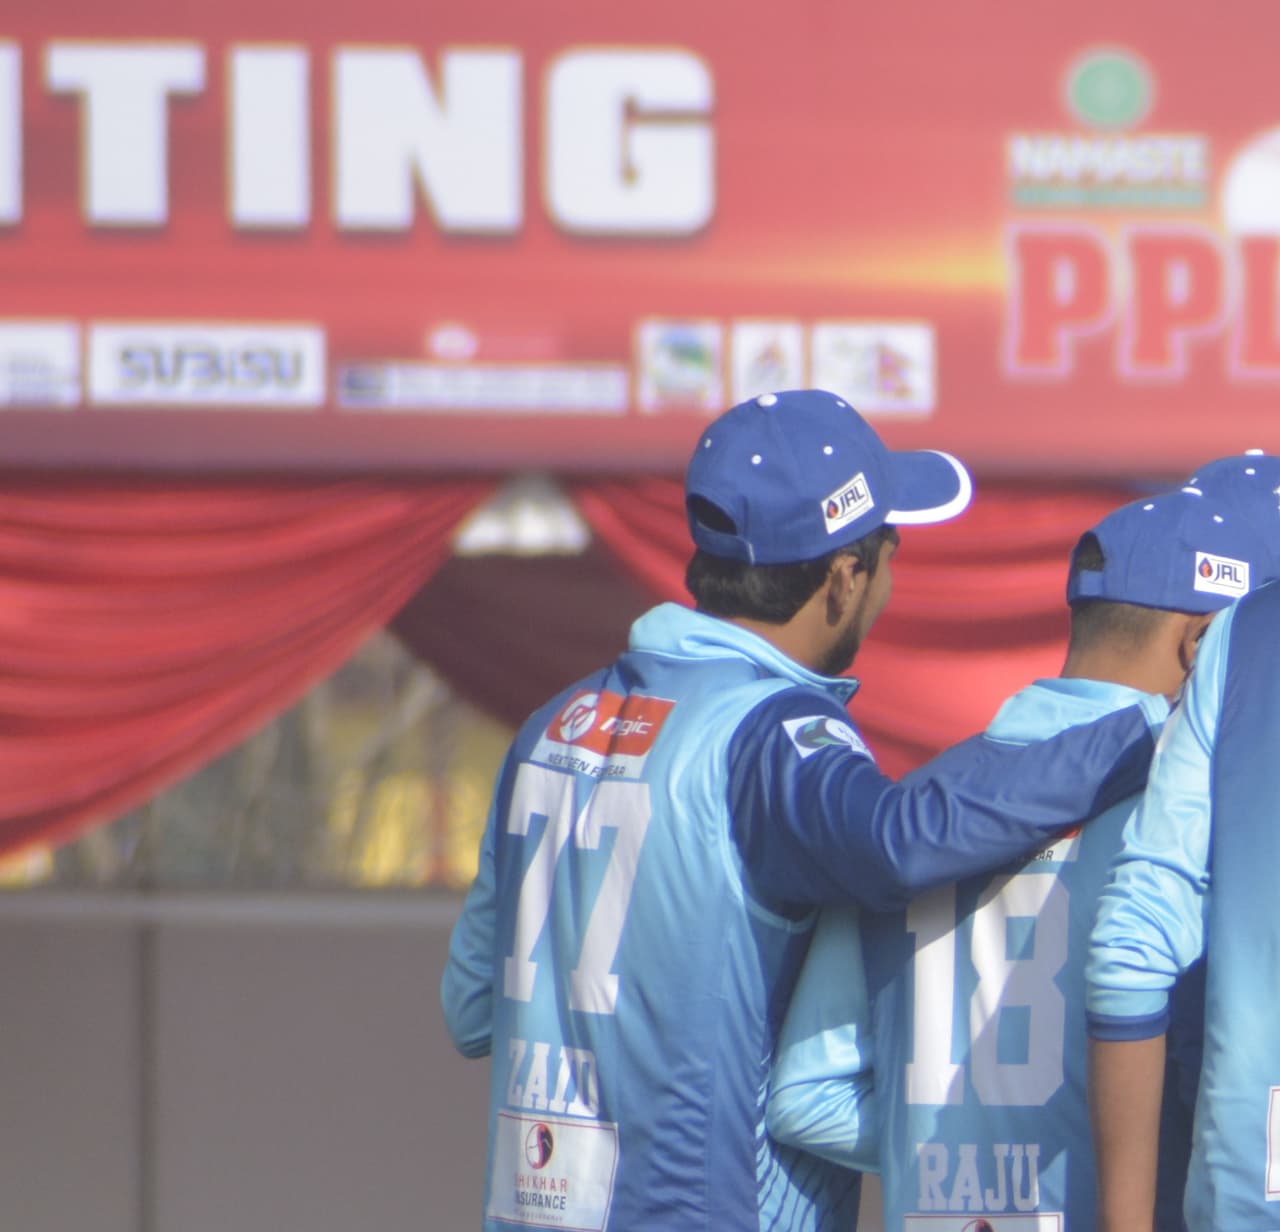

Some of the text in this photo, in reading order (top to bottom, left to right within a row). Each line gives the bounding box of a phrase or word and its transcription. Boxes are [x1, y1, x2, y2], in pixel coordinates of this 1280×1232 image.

[0, 41, 716, 236] TING
[503, 763, 652, 1015] 77
[904, 871, 1072, 1106] 18
[916, 1142, 1041, 1213] RAJU
